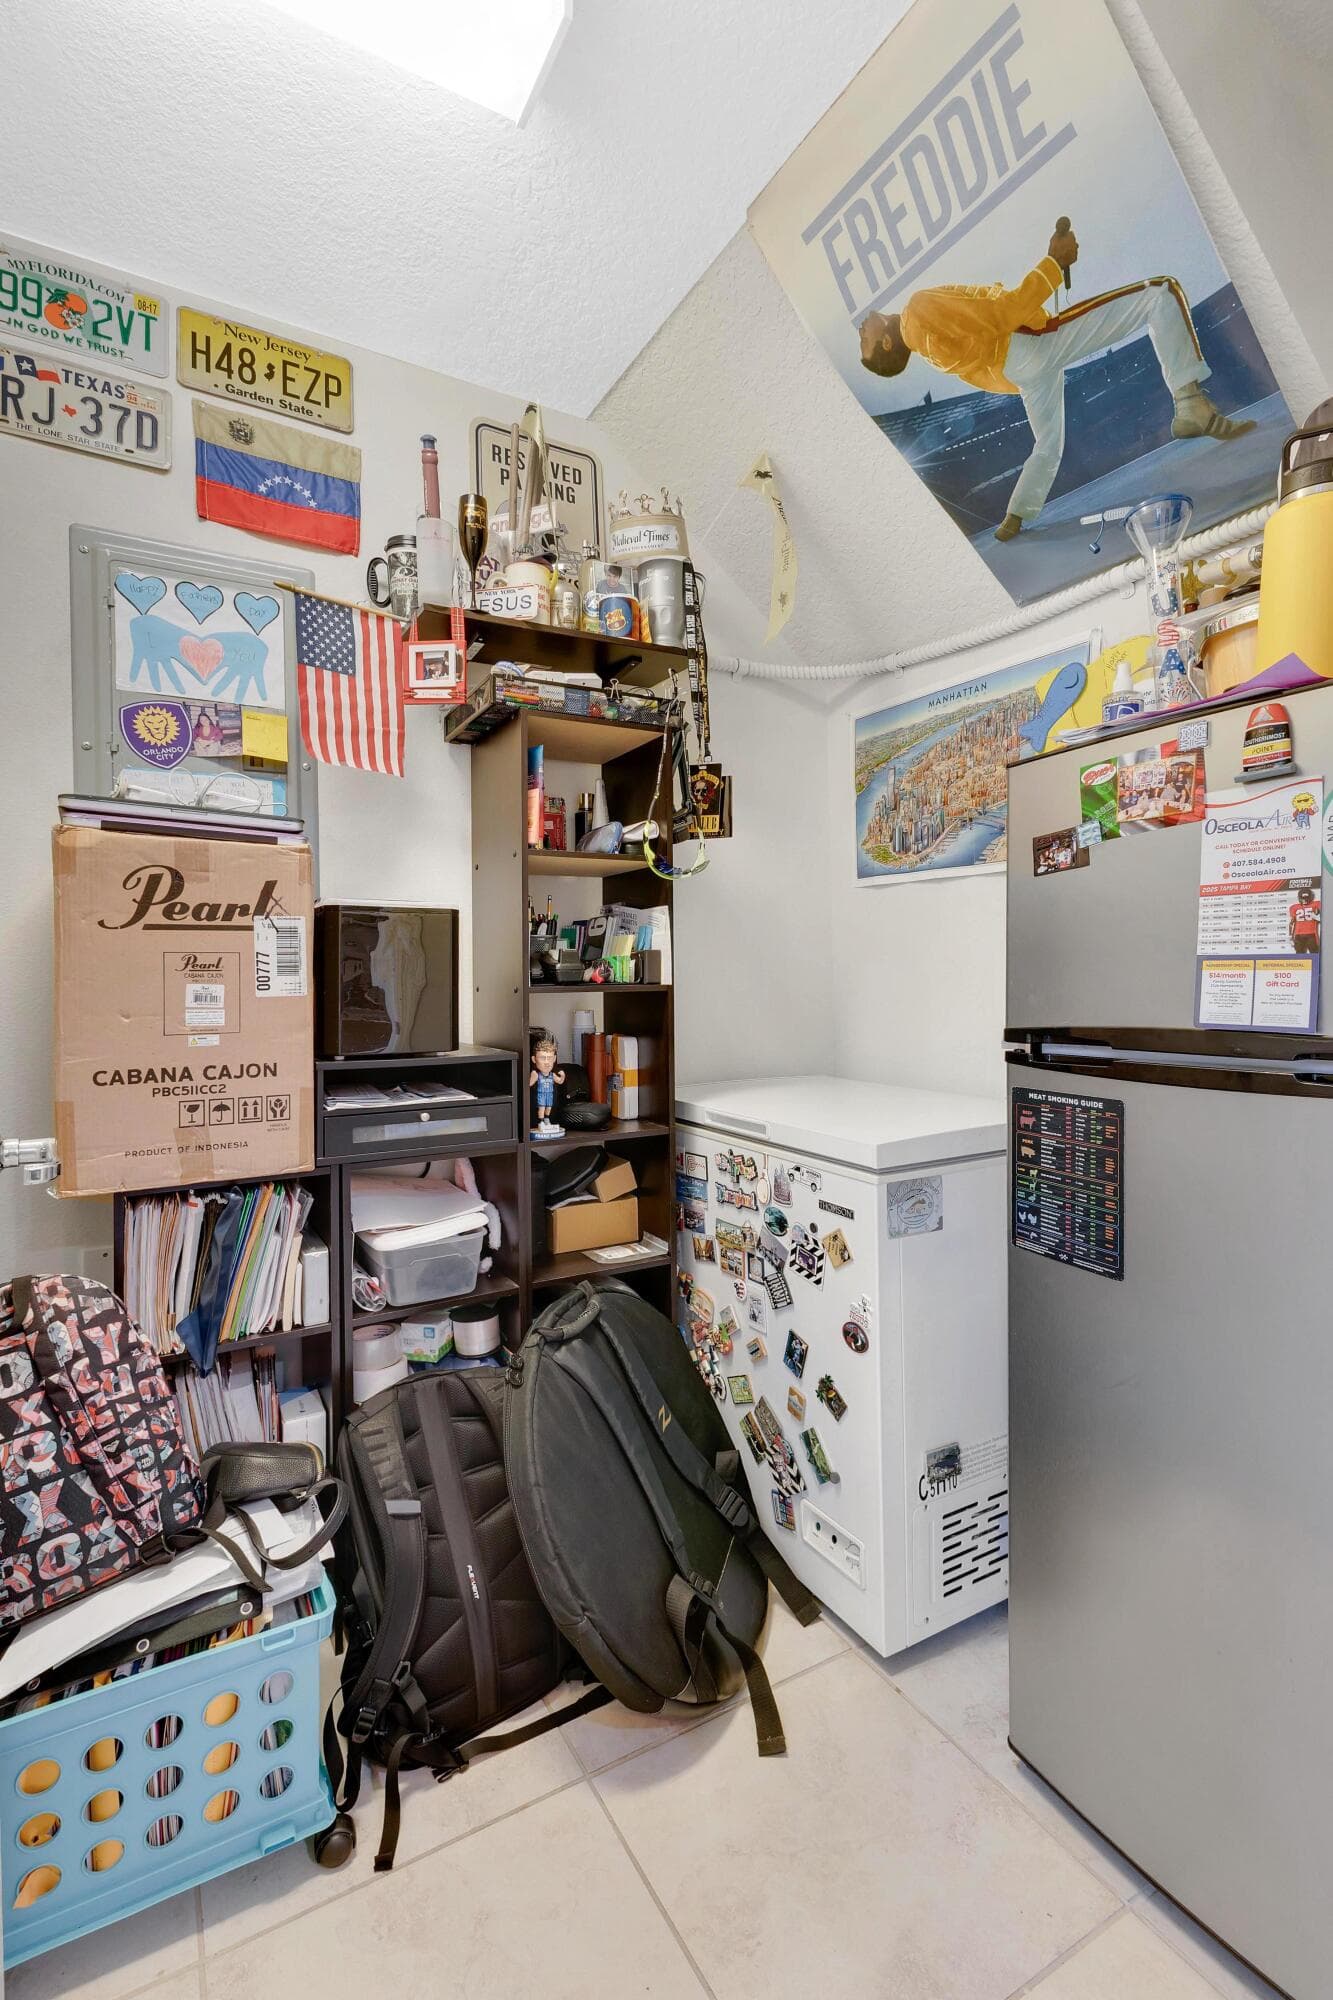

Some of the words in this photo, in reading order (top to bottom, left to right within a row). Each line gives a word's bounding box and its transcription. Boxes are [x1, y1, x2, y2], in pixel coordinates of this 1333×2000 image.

[820, 27, 1048, 315] FREDDIE
[7, 258, 126, 304] MYFLORIDA.COM
[136, 299, 158, 315] 08-17
[92, 299, 158, 352] 2VT
[27, 323, 60, 340] GOD
[63, 332, 84, 349] WE
[86, 339, 126, 358] TRUST
[223, 323, 262, 346] New
[263, 335, 312, 364] Jersey
[190, 331, 258, 386] H48
[282, 359, 343, 409] EZP
[61, 367, 126, 400] TEXAS
[225, 383, 275, 406] Garden
[278, 399, 314, 418] State
[79, 395, 159, 451] 37D
[15, 421, 34, 432] THE
[37, 427, 63, 440] LONE
[66, 434, 91, 446] STAR
[94, 440, 121, 453] STATE
[491, 443, 582, 486] RESVED
[642, 529, 671, 544] Times
[928, 681, 988, 709] MANHATTAN
[143, 746, 184, 757] ORLANDO
[156, 753, 175, 762] CITY
[1251, 744, 1274, 755] POINT
[1204, 818, 1265, 836] OSCEOLA
[1229, 841, 1250, 849] TODAY
[1259, 834, 1307, 847] CONVENIENTLY
[1231, 856, 1287, 868] 407.584.4908
[1231, 867, 1296, 879] OsceolaAir.com
[97, 863, 278, 931] Pearl
[1295, 907, 1314, 922] 25
[174, 953, 223, 972] Pearl
[256, 951, 271, 991] 00777
[92, 1066, 194, 1087] CABANA
[202, 1062, 279, 1081] CAJON
[1028, 1092, 1047, 1101] MEAT
[1047, 1095, 1079, 1106] SMOKING
[1080, 1099, 1104, 1110] GUIDE
[124, 1146, 173, 1159] PRODUCT
[177, 1145, 190, 1155] OF
[195, 1140, 249, 1153] INDONESIA
